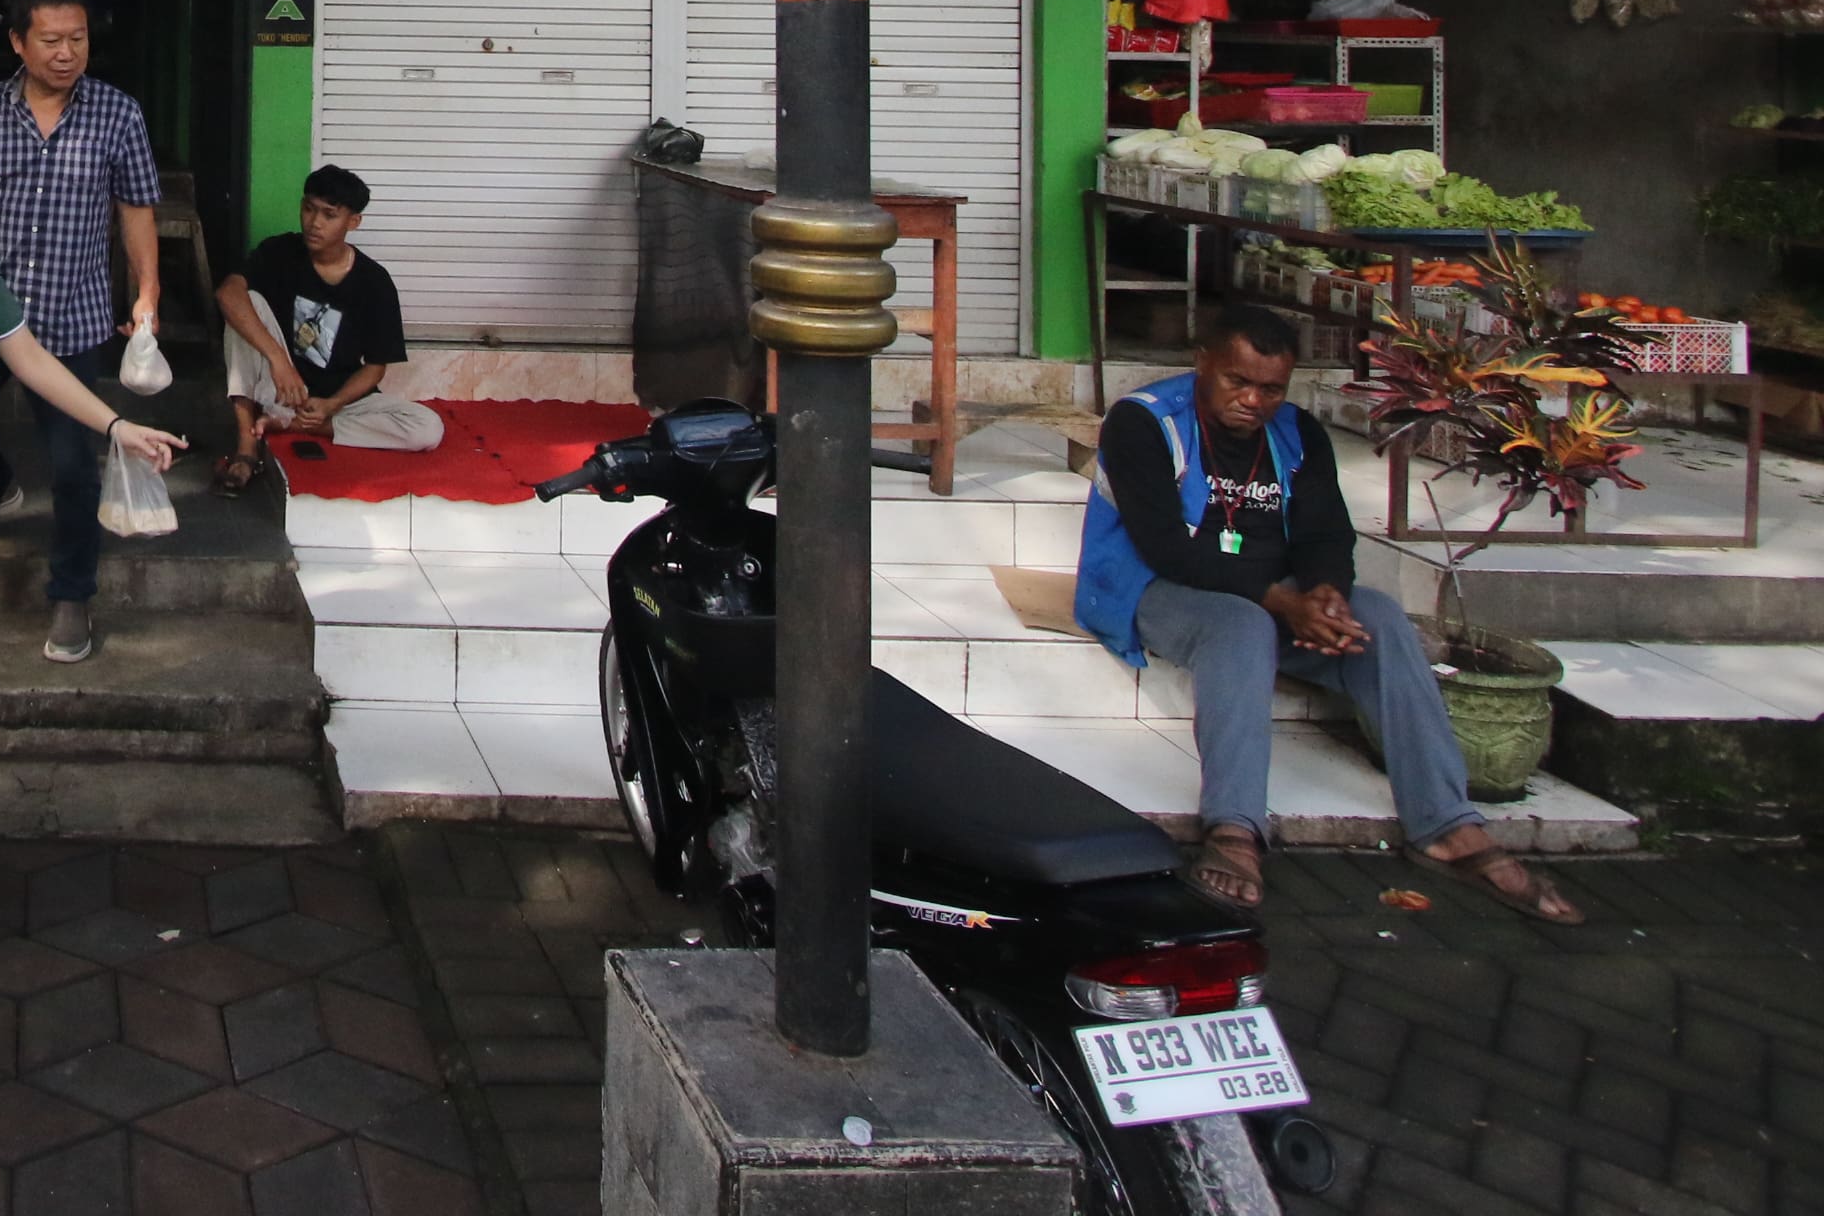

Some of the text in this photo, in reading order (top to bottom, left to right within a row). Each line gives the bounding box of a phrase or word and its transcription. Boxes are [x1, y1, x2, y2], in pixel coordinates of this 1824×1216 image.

[1094, 1016, 1271, 1076] N 933 WEE
[1218, 1071, 1290, 1100] 03.28
